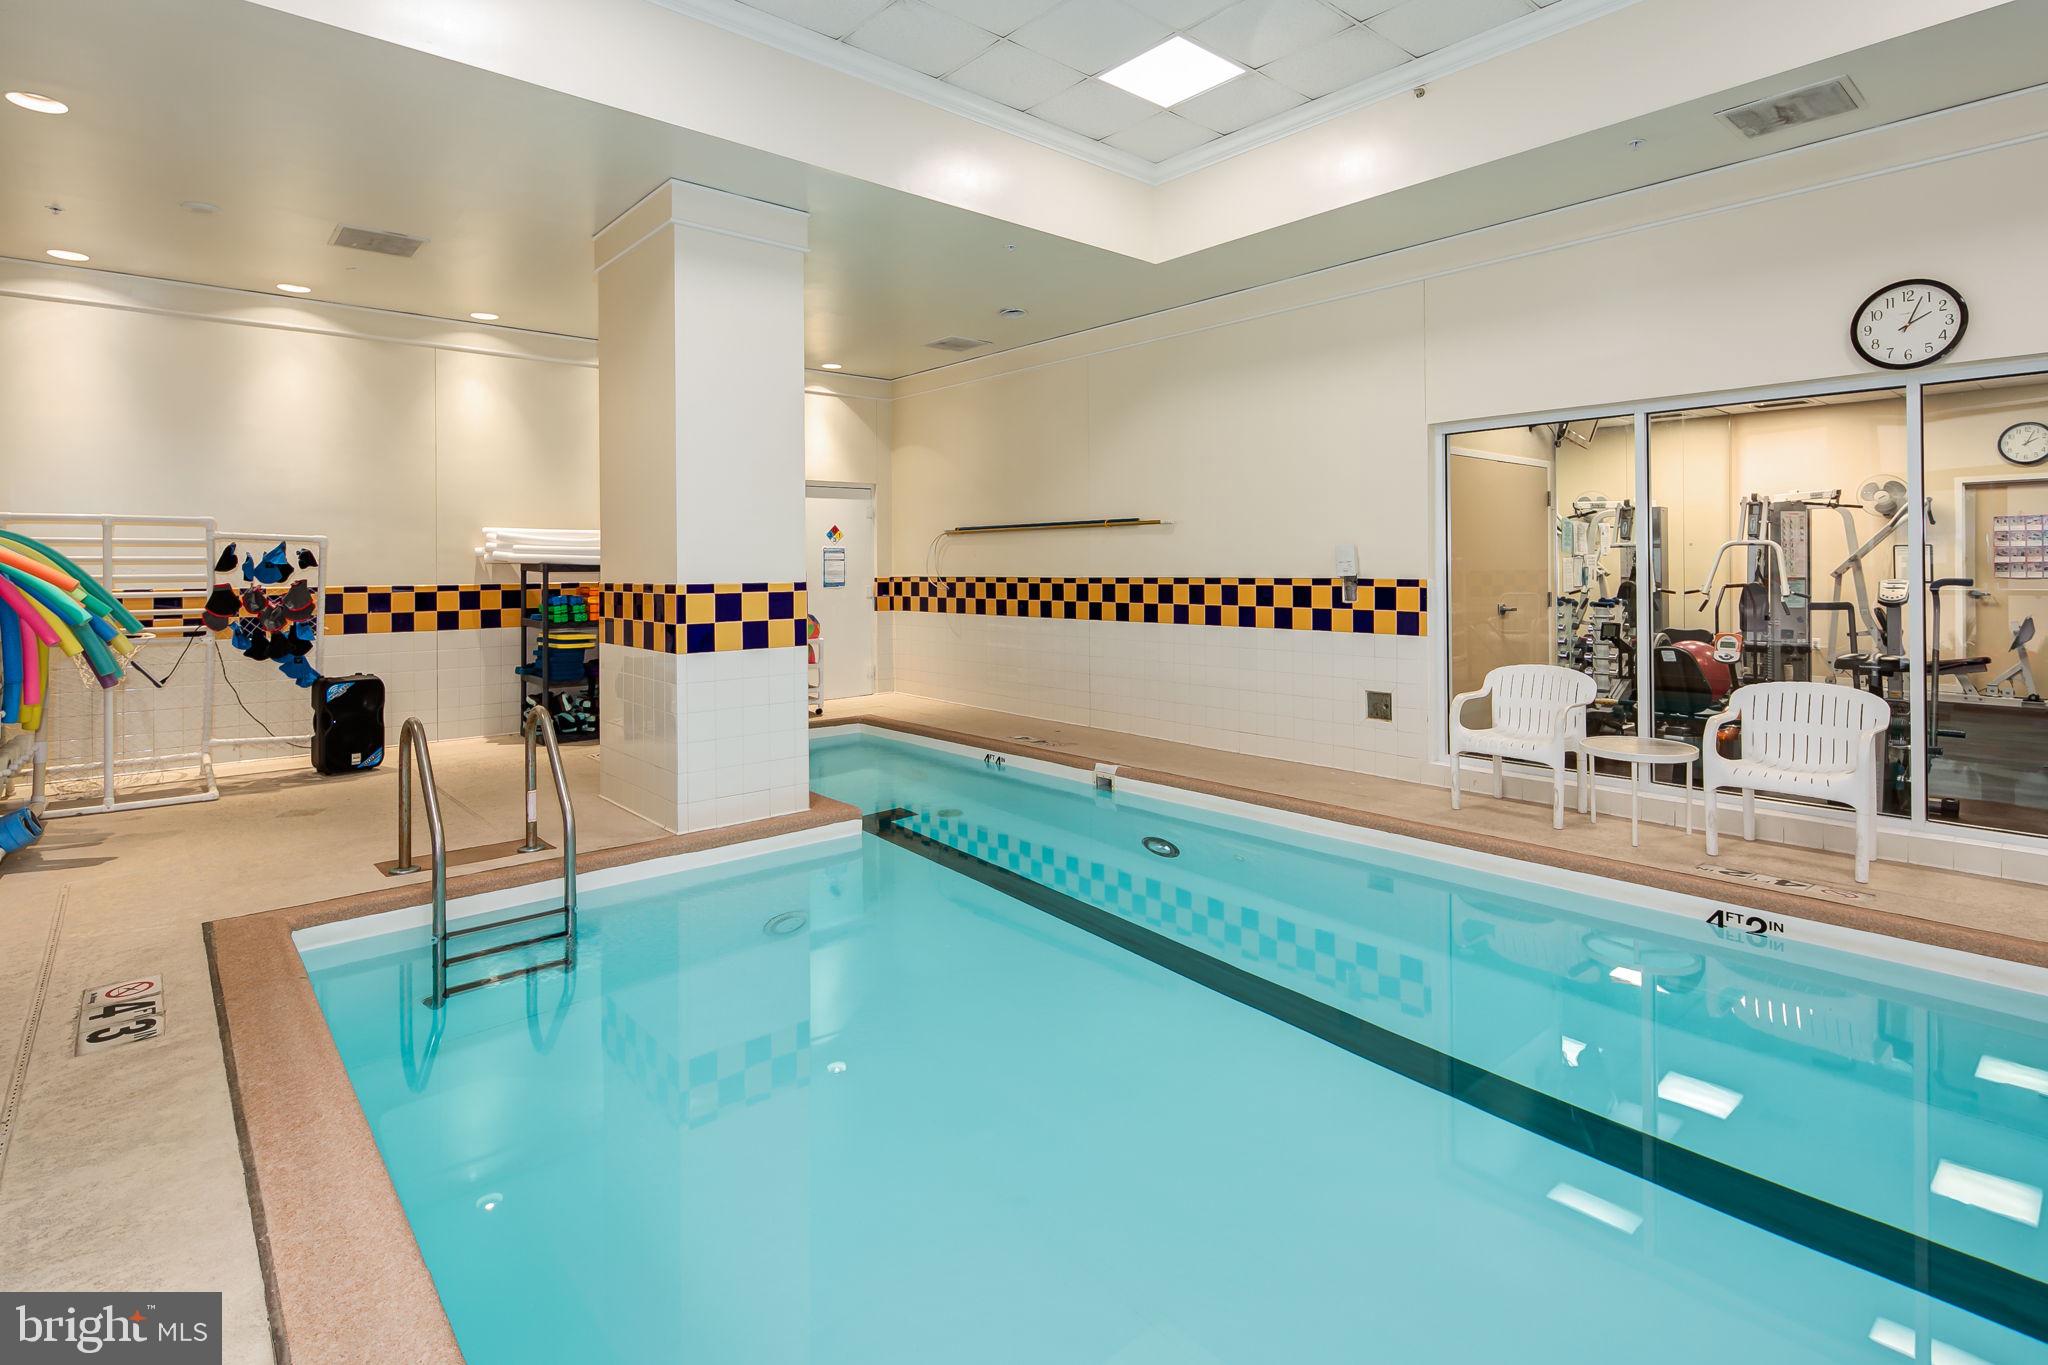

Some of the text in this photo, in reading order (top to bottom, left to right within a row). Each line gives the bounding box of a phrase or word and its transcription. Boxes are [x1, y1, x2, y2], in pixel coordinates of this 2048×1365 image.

[1902, 290, 1914, 302] 12
[1927, 292, 1931, 302] 1
[1886, 298, 1894, 309] 11
[1938, 300, 1948, 311] 2
[1871, 310, 1882, 322] 10
[1945, 314, 1954, 325] 3
[1864, 326, 1872, 336] 9
[1938, 329, 1947, 340] 4
[1872, 339, 1880, 350] 8
[1924, 342, 1934, 354] 5
[1886, 348, 1894, 358] 7
[1904, 349, 1912, 360] 6
